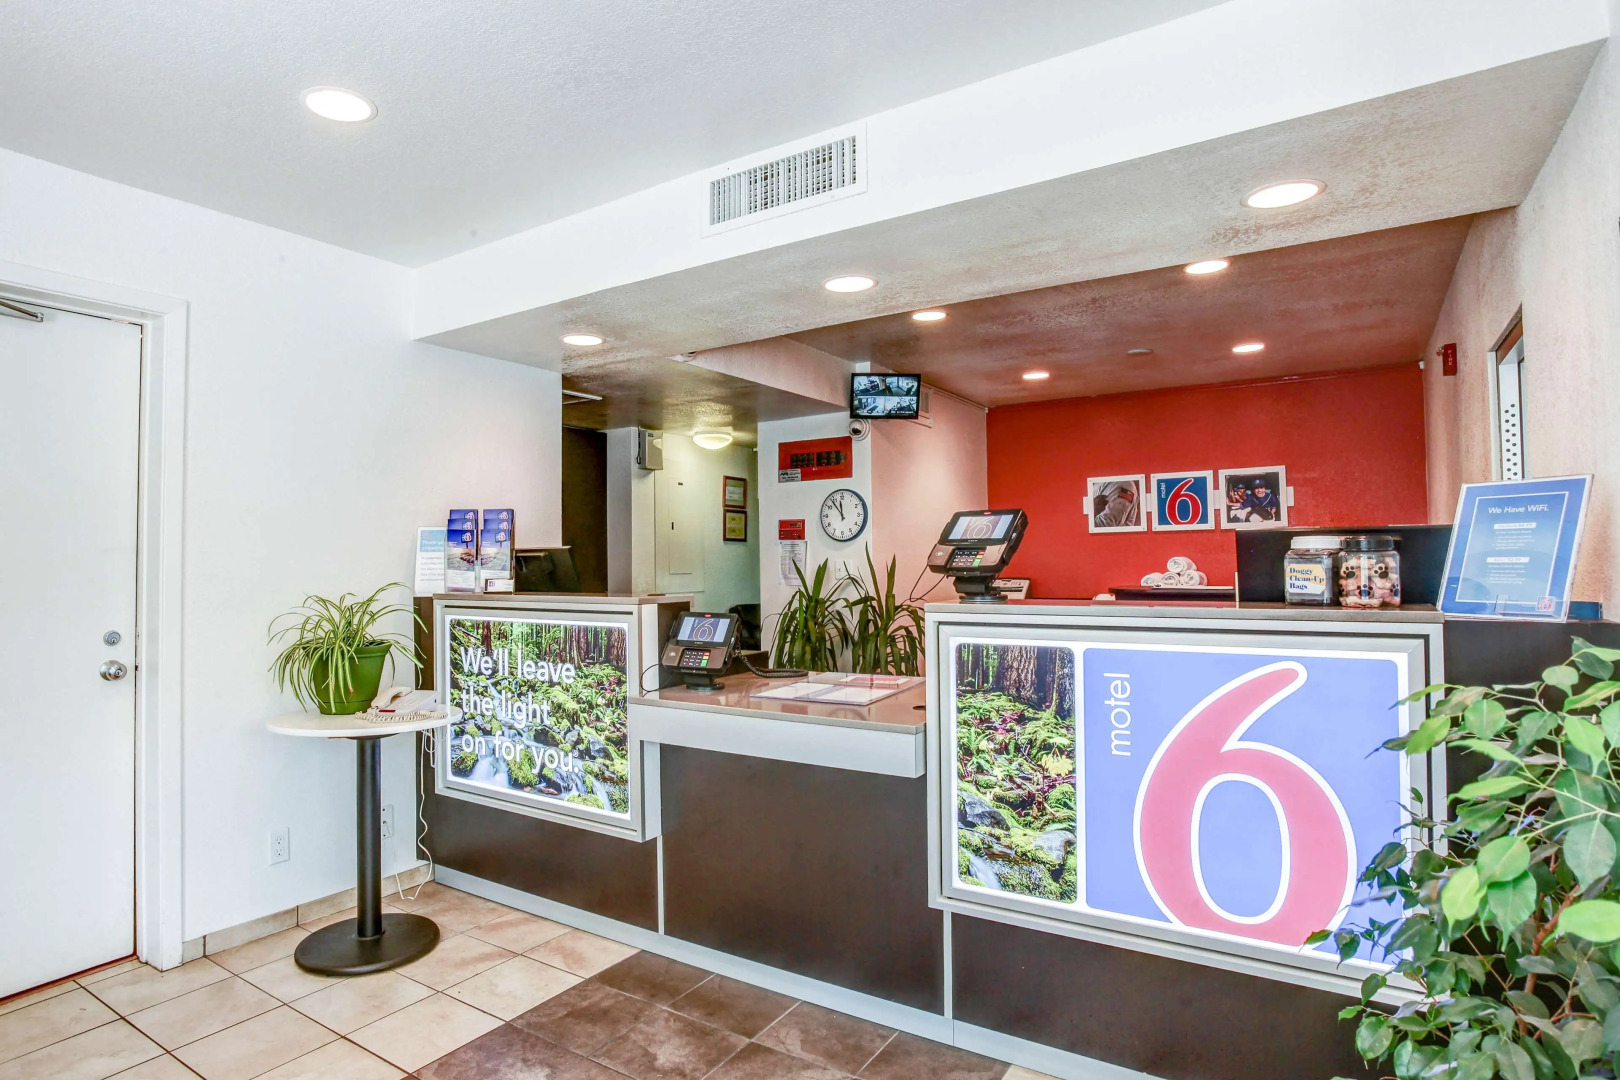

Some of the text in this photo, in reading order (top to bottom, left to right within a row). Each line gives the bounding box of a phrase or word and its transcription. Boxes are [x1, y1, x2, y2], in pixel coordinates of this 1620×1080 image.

[1166, 477, 1202, 525] 6
[1488, 506, 1502, 514] We
[1504, 505, 1526, 514] Have
[1289, 567, 1313, 575] Doggy
[1289, 575, 1325, 583] Clean-Up
[1289, 582, 1308, 590] Bags
[693, 618, 714, 641] 6
[460, 646, 576, 684] We'll leave
[460, 685, 551, 729] the light
[461, 734, 486, 756] on
[494, 730, 525, 762] for
[1103, 660, 1357, 949] motel 6
